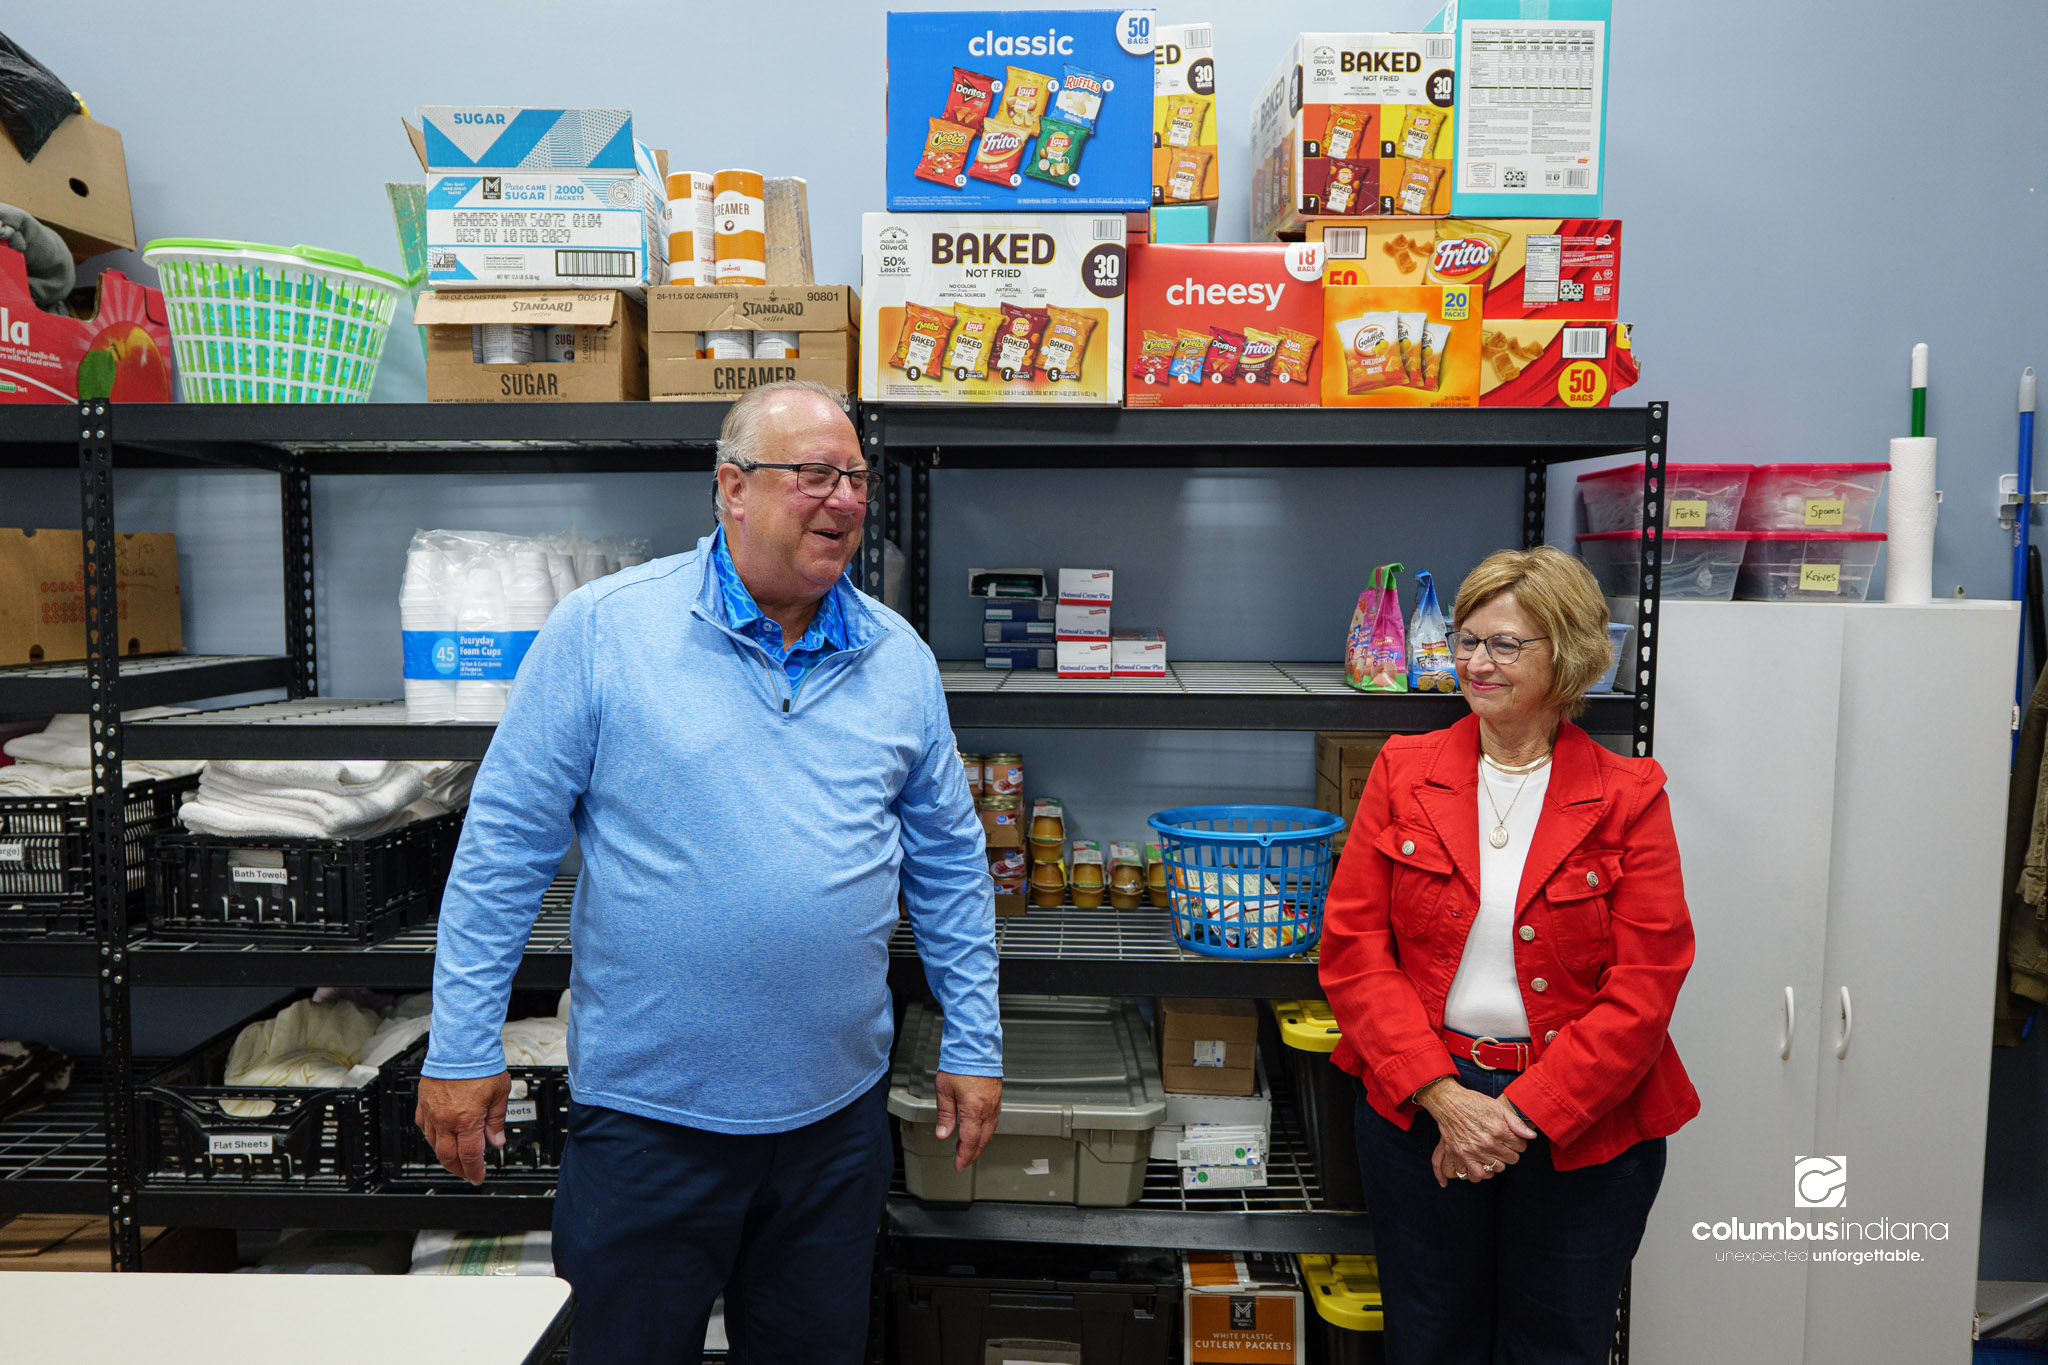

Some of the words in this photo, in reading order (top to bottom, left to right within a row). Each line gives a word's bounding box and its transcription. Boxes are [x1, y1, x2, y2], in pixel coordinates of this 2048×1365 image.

[1128, 17, 1149, 37] 50
[968, 29, 1073, 56] classic
[1341, 52, 1422, 73] BAKED
[1195, 65, 1212, 82] 30
[1065, 76, 1100, 93] RUFFLES
[1434, 77, 1451, 94] 30
[955, 84, 986, 99] Doritos
[1017, 86, 1036, 97] Lay's
[1260, 76, 1285, 131] BAKED
[454, 113, 506, 125] SUGAR
[1172, 119, 1193, 128] BAKED
[931, 131, 965, 147] Cheetos
[1333, 128, 1353, 138] BAKED
[1408, 130, 1428, 139] BAKED
[984, 133, 1020, 153] Fritos
[1050, 137, 1069, 148] Lay's
[1310, 143, 1316, 153] 9
[1386, 143, 1392, 153] 9
[1176, 172, 1195, 181] BAKED
[504, 182, 524, 190] Pure
[555, 185, 584, 196] 2000
[1331, 183, 1351, 193] BAKED
[1408, 185, 1426, 194] BAKED
[505, 191, 545, 200] SUGAR
[714, 203, 750, 216] CREAMER
[453, 212, 498, 227] MEMBERS
[501, 212, 527, 228] MARK
[456, 228, 481, 243] BEST
[484, 229, 498, 243] BY
[520, 229, 538, 243] FEB
[541, 229, 571, 243] 2029
[931, 232, 1056, 266] BAKED
[883, 256, 906, 266] 50%
[1298, 249, 1315, 266] 18
[1434, 239, 1493, 272] Fritos
[1562, 256, 1595, 264] GUARANTEED
[1093, 254, 1119, 279] 30
[966, 269, 987, 278] NOT
[991, 269, 1021, 278] FRIED
[1329, 270, 1357, 285] 50
[577, 294, 610, 302] 90514
[696, 292, 739, 300] CANISTERS
[807, 292, 839, 301] 90801
[1166, 279, 1285, 312] cheesy
[1445, 293, 1467, 307] 20
[511, 301, 573, 313] STANDARD
[742, 302, 804, 316] STANDARD
[0, 306, 29, 346] la
[915, 320, 939, 331] Cheetos
[965, 321, 985, 331] Lay's
[1012, 321, 1031, 332] Lay's
[911, 334, 935, 348] BAKED
[956, 336, 982, 349] BAKED
[1003, 336, 1028, 350] BAKED
[1180, 338, 1207, 350] Cheetos
[1285, 339, 1300, 349] Sun
[1358, 328, 1385, 348] Goldfish
[1050, 339, 1073, 352] BAKED
[1144, 339, 1172, 351] Cheetos
[1212, 340, 1237, 353] Doritos
[1243, 341, 1274, 355] Fritos
[1361, 356, 1386, 366] CHEDDAR
[501, 373, 558, 396] SUGAR
[1569, 369, 1596, 393] 50
[1675, 508, 1700, 519] Forks
[1810, 505, 1841, 517] Spoons
[1805, 571, 1837, 582] Knives
[1061, 591, 1081, 599] Oatmeal
[1058, 627, 1079, 636] Oatmeal
[1096, 628, 1107, 636] Pies
[460, 636, 494, 647] Everyday
[436, 647, 454, 661] 45
[460, 647, 479, 655] Foam
[481, 647, 501, 657] Cups
[1114, 663, 1135, 671] Oatmeal
[234, 870, 254, 879] Bath
[256, 870, 286, 880] Towels
[213, 1140, 233, 1149] Flat
[235, 1139, 268, 1149] Sheets
[1195, 1340, 1241, 1349] CUTLERY
[1245, 1341, 1291, 1350] PACKETS
